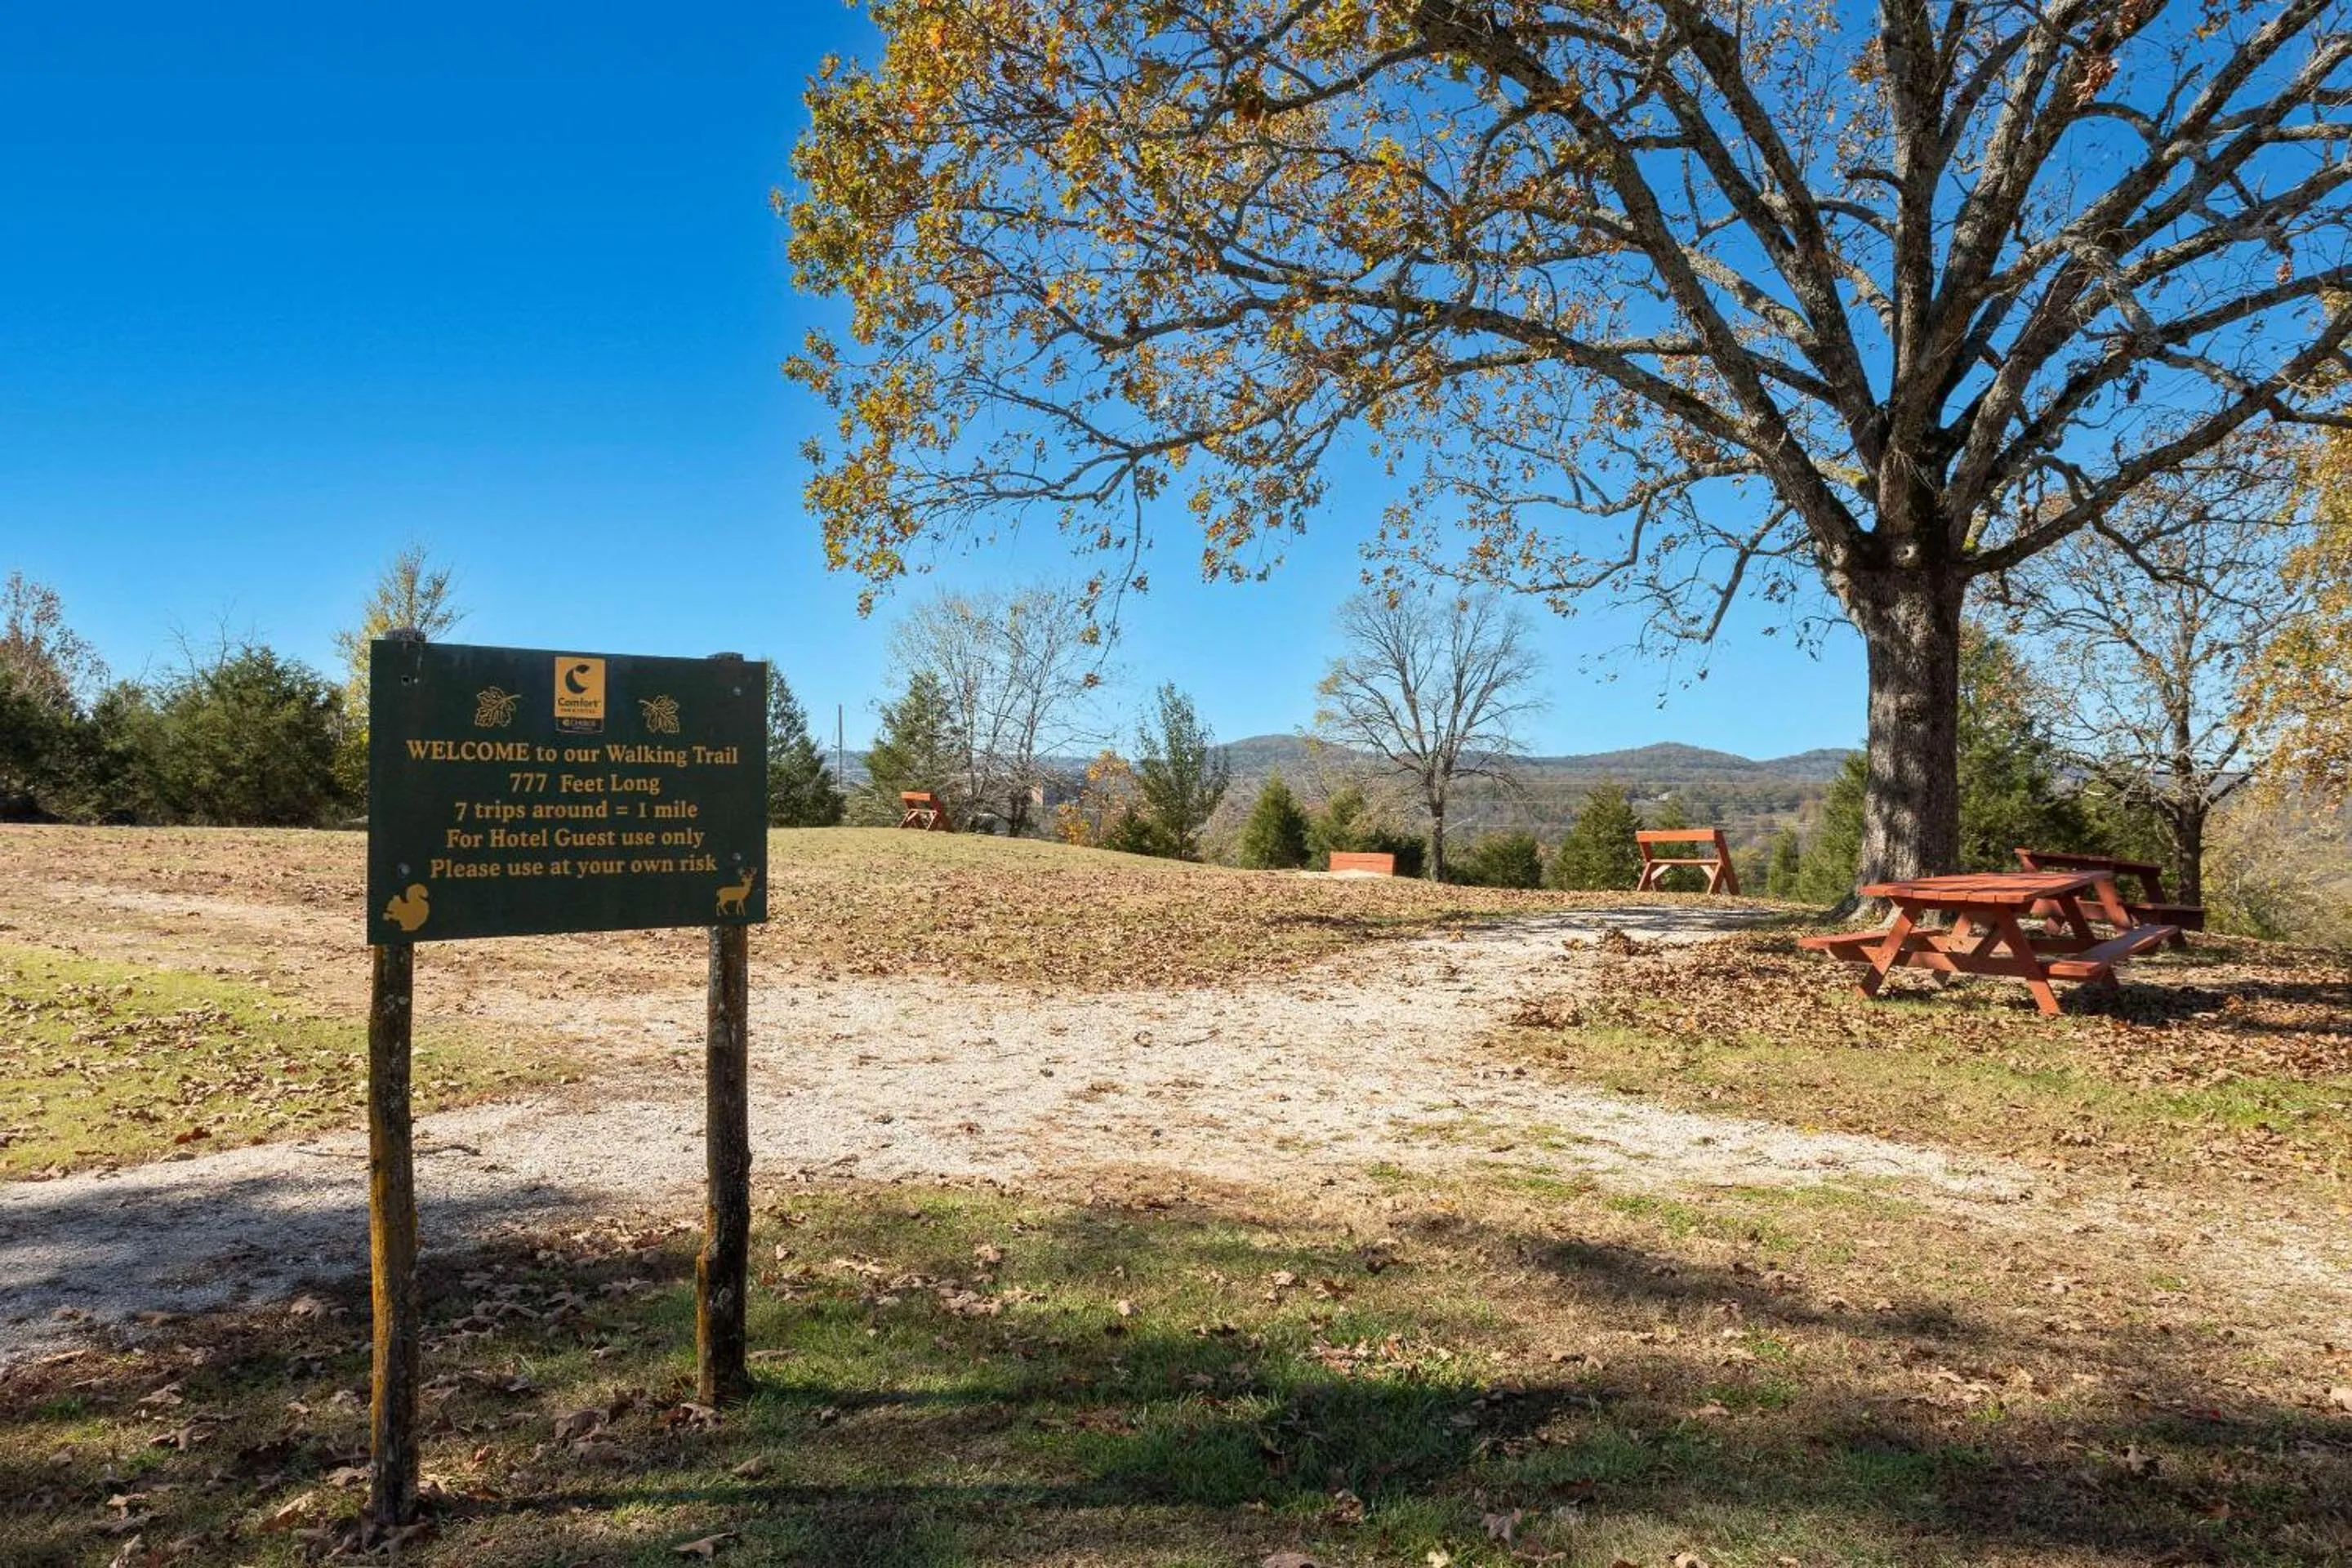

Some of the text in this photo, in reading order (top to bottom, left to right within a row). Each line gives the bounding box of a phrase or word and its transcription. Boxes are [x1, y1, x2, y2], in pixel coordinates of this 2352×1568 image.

[558, 697, 599, 708] Comfort
[407, 740, 738, 767] WELCOME to our Walking Trail
[510, 773, 660, 795] 777 Feet Long
[455, 800, 698, 822] 7 trips around = 1 mile
[447, 828, 704, 848] For Hotel Guest use only
[430, 854, 717, 878] Please use at your own risk
